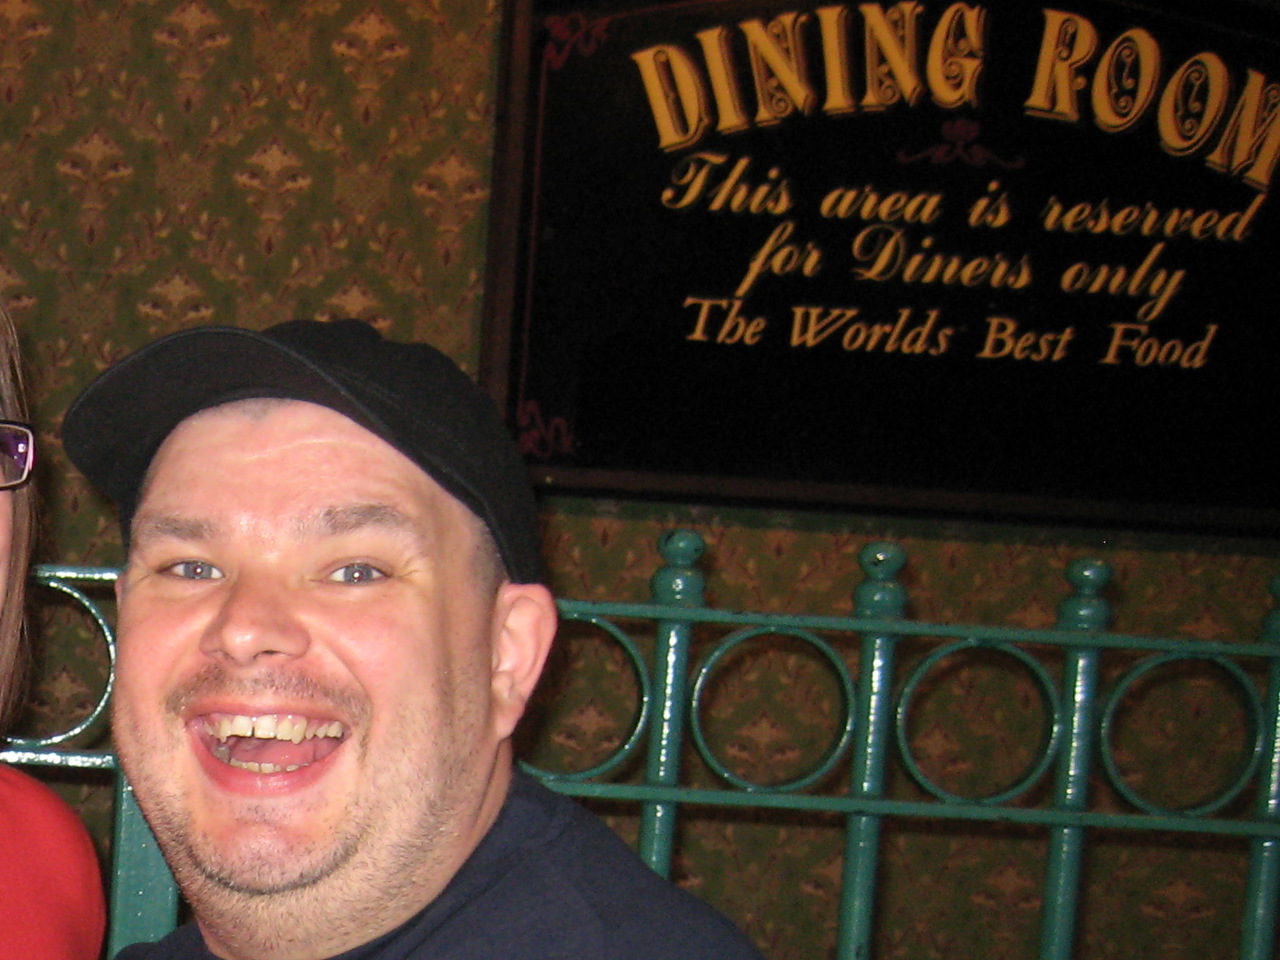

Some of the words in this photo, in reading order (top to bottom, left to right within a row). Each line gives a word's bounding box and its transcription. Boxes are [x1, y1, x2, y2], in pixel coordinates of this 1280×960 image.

[631, 1, 987, 152] DINING
[1025, 7, 1280, 190] ROOM
[661, 152, 793, 214] This
[820, 181, 942, 224] area
[967, 180, 1011, 228] is
[1042, 192, 1267, 242] reserved
[735, 222, 822, 297] for
[852, 223, 1033, 289] Diners
[1060, 242, 1186, 322] only
[683, 297, 766, 346] The
[791, 306, 952, 358] Worlds
[977, 316, 1074, 362] Best
[1100, 322, 1217, 369] Food
